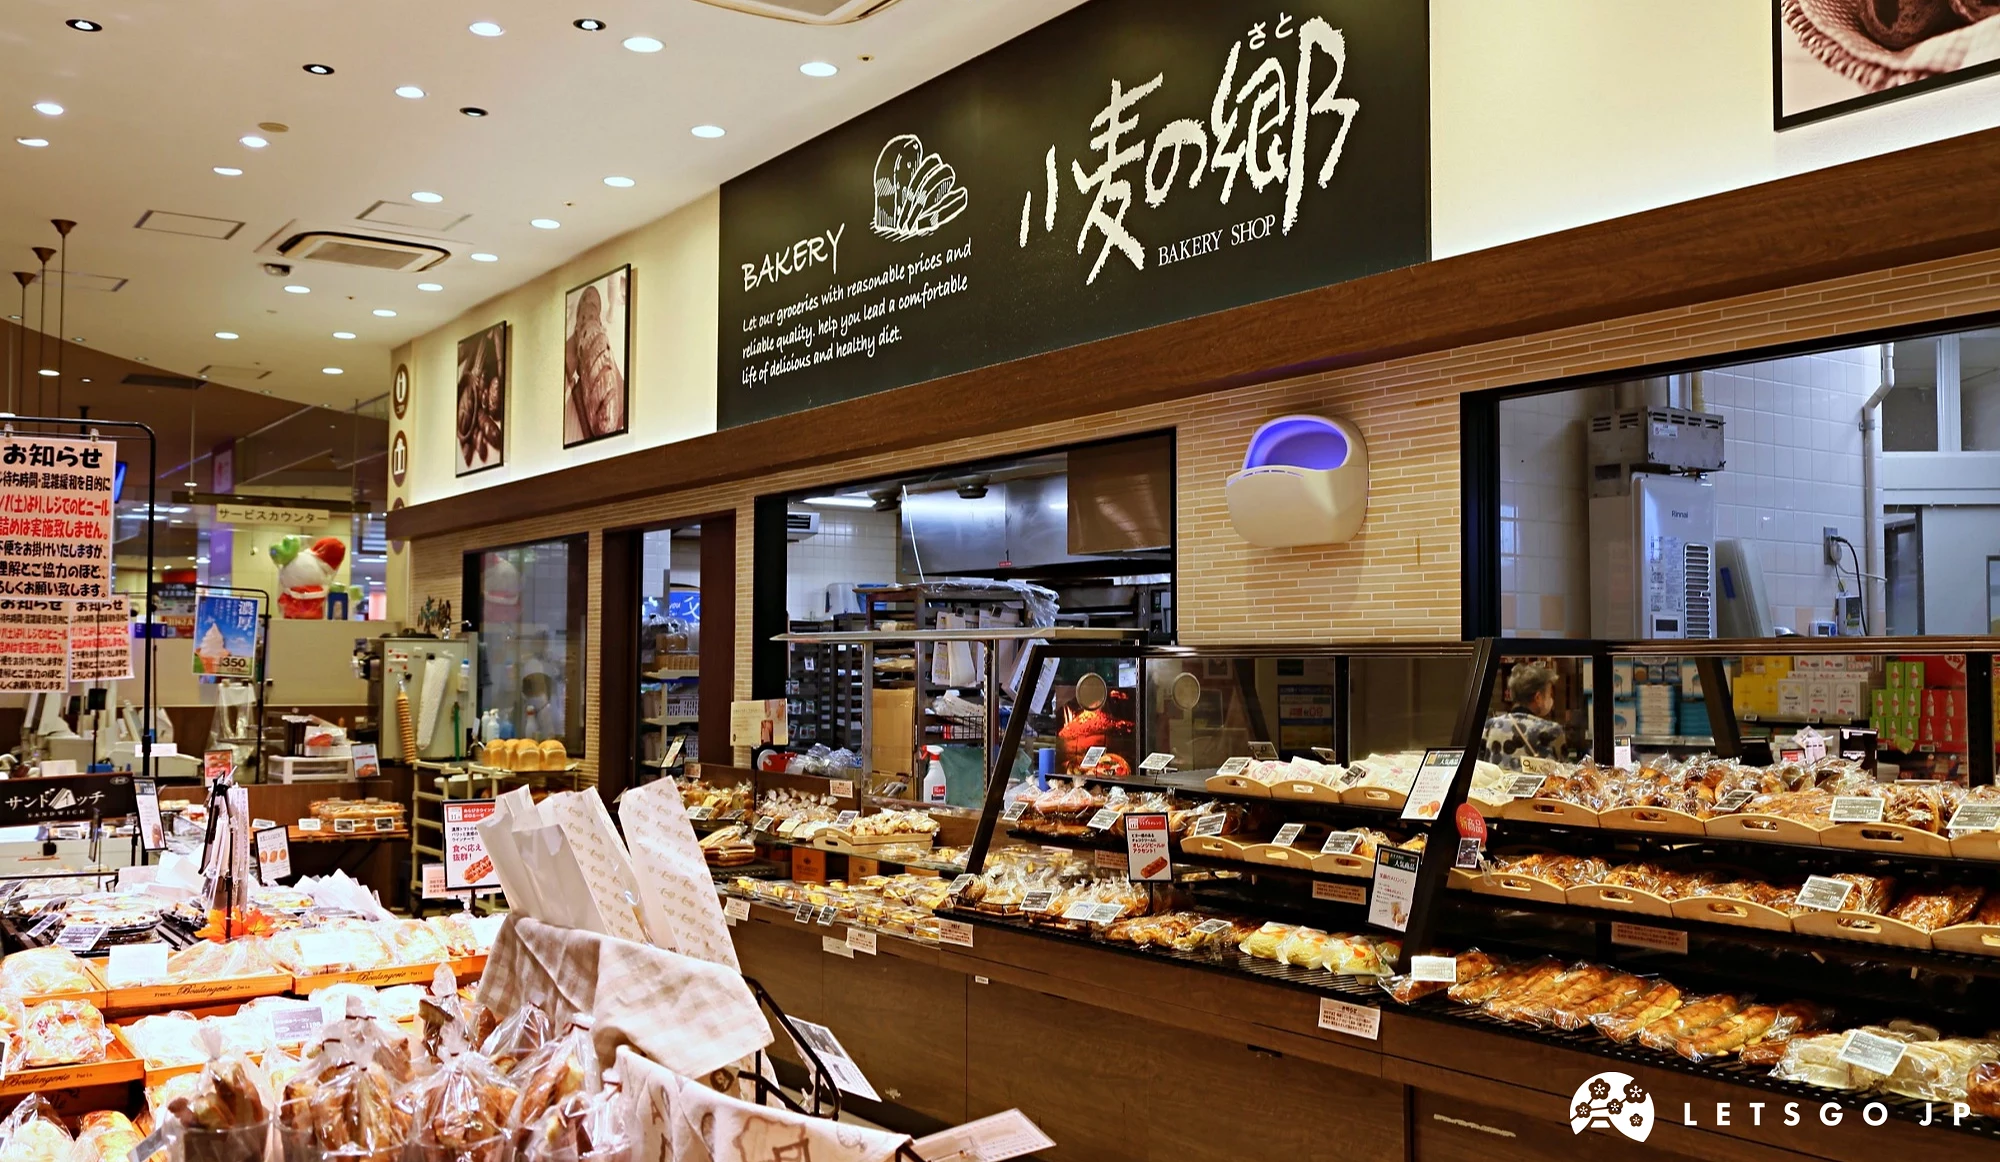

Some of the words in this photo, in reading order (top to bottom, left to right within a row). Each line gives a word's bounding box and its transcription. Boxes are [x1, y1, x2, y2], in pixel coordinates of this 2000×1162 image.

[1247, 12, 1293, 50] さと
[1158, 229, 1223, 267] BAKERY
[1231, 214, 1276, 246] SHOP
[741, 222, 846, 292] BAKERY
[742, 315, 758, 332] Let
[758, 312, 775, 327] our
[776, 293, 819, 327] groceries
[821, 283, 844, 306] with
[847, 263, 905, 298] reasonable
[907, 252, 943, 285] prices
[945, 236, 972, 264] and
[742, 333, 775, 359] reliable
[818, 316, 838, 339] help
[840, 309, 861, 337] you
[863, 297, 886, 321] lead
[888, 298, 896, 314] a
[898, 273, 969, 310] comfortable
[742, 366, 757, 389] life
[758, 363, 769, 385] of
[769, 351, 812, 378] delicious
[813, 343, 834, 365] and
[836, 332, 876, 359] healthy
[878, 324, 903, 347] diet.
[3, 443, 103, 469] お知らせ
[0, 471, 111, 491] 待ち時間・混雑緩和を目的に
[218, 509, 328, 524] サービスカウンター
[1671, 510, 1689, 518] Rinnai
[222, 657, 247, 668] 350
[5, 788, 105, 811] サンドイッチ
[27, 809, 86, 818] SANDWICH
[1459, 815, 1484, 834] 新商品
[452, 843, 482, 853] 食べ応え
[177, 978, 233, 997] Boulangerie
[356, 970, 407, 986] Boulangerie
[2, 1072, 71, 1088] Boulangerie
